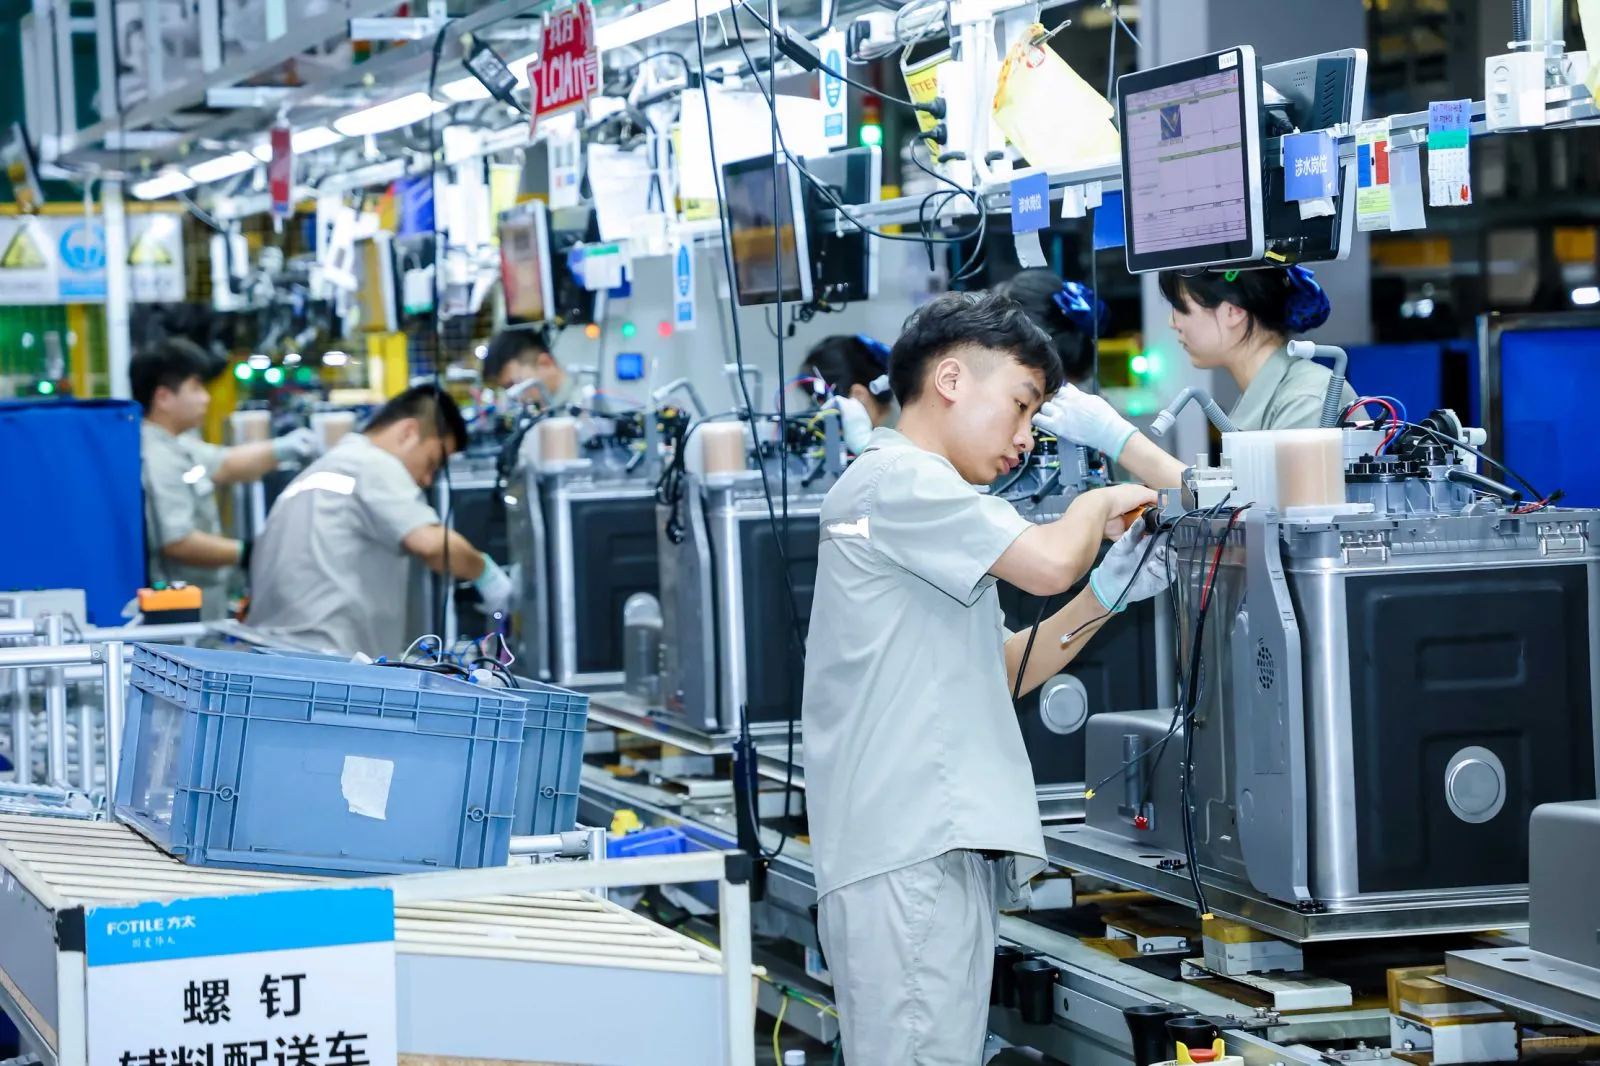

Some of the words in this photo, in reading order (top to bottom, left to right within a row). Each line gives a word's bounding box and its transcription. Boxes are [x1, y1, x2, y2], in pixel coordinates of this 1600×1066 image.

[1294, 154, 1328, 177] 涉水岗位
[106, 918, 164, 936] FOTILE
[167, 915, 197, 930] 方太
